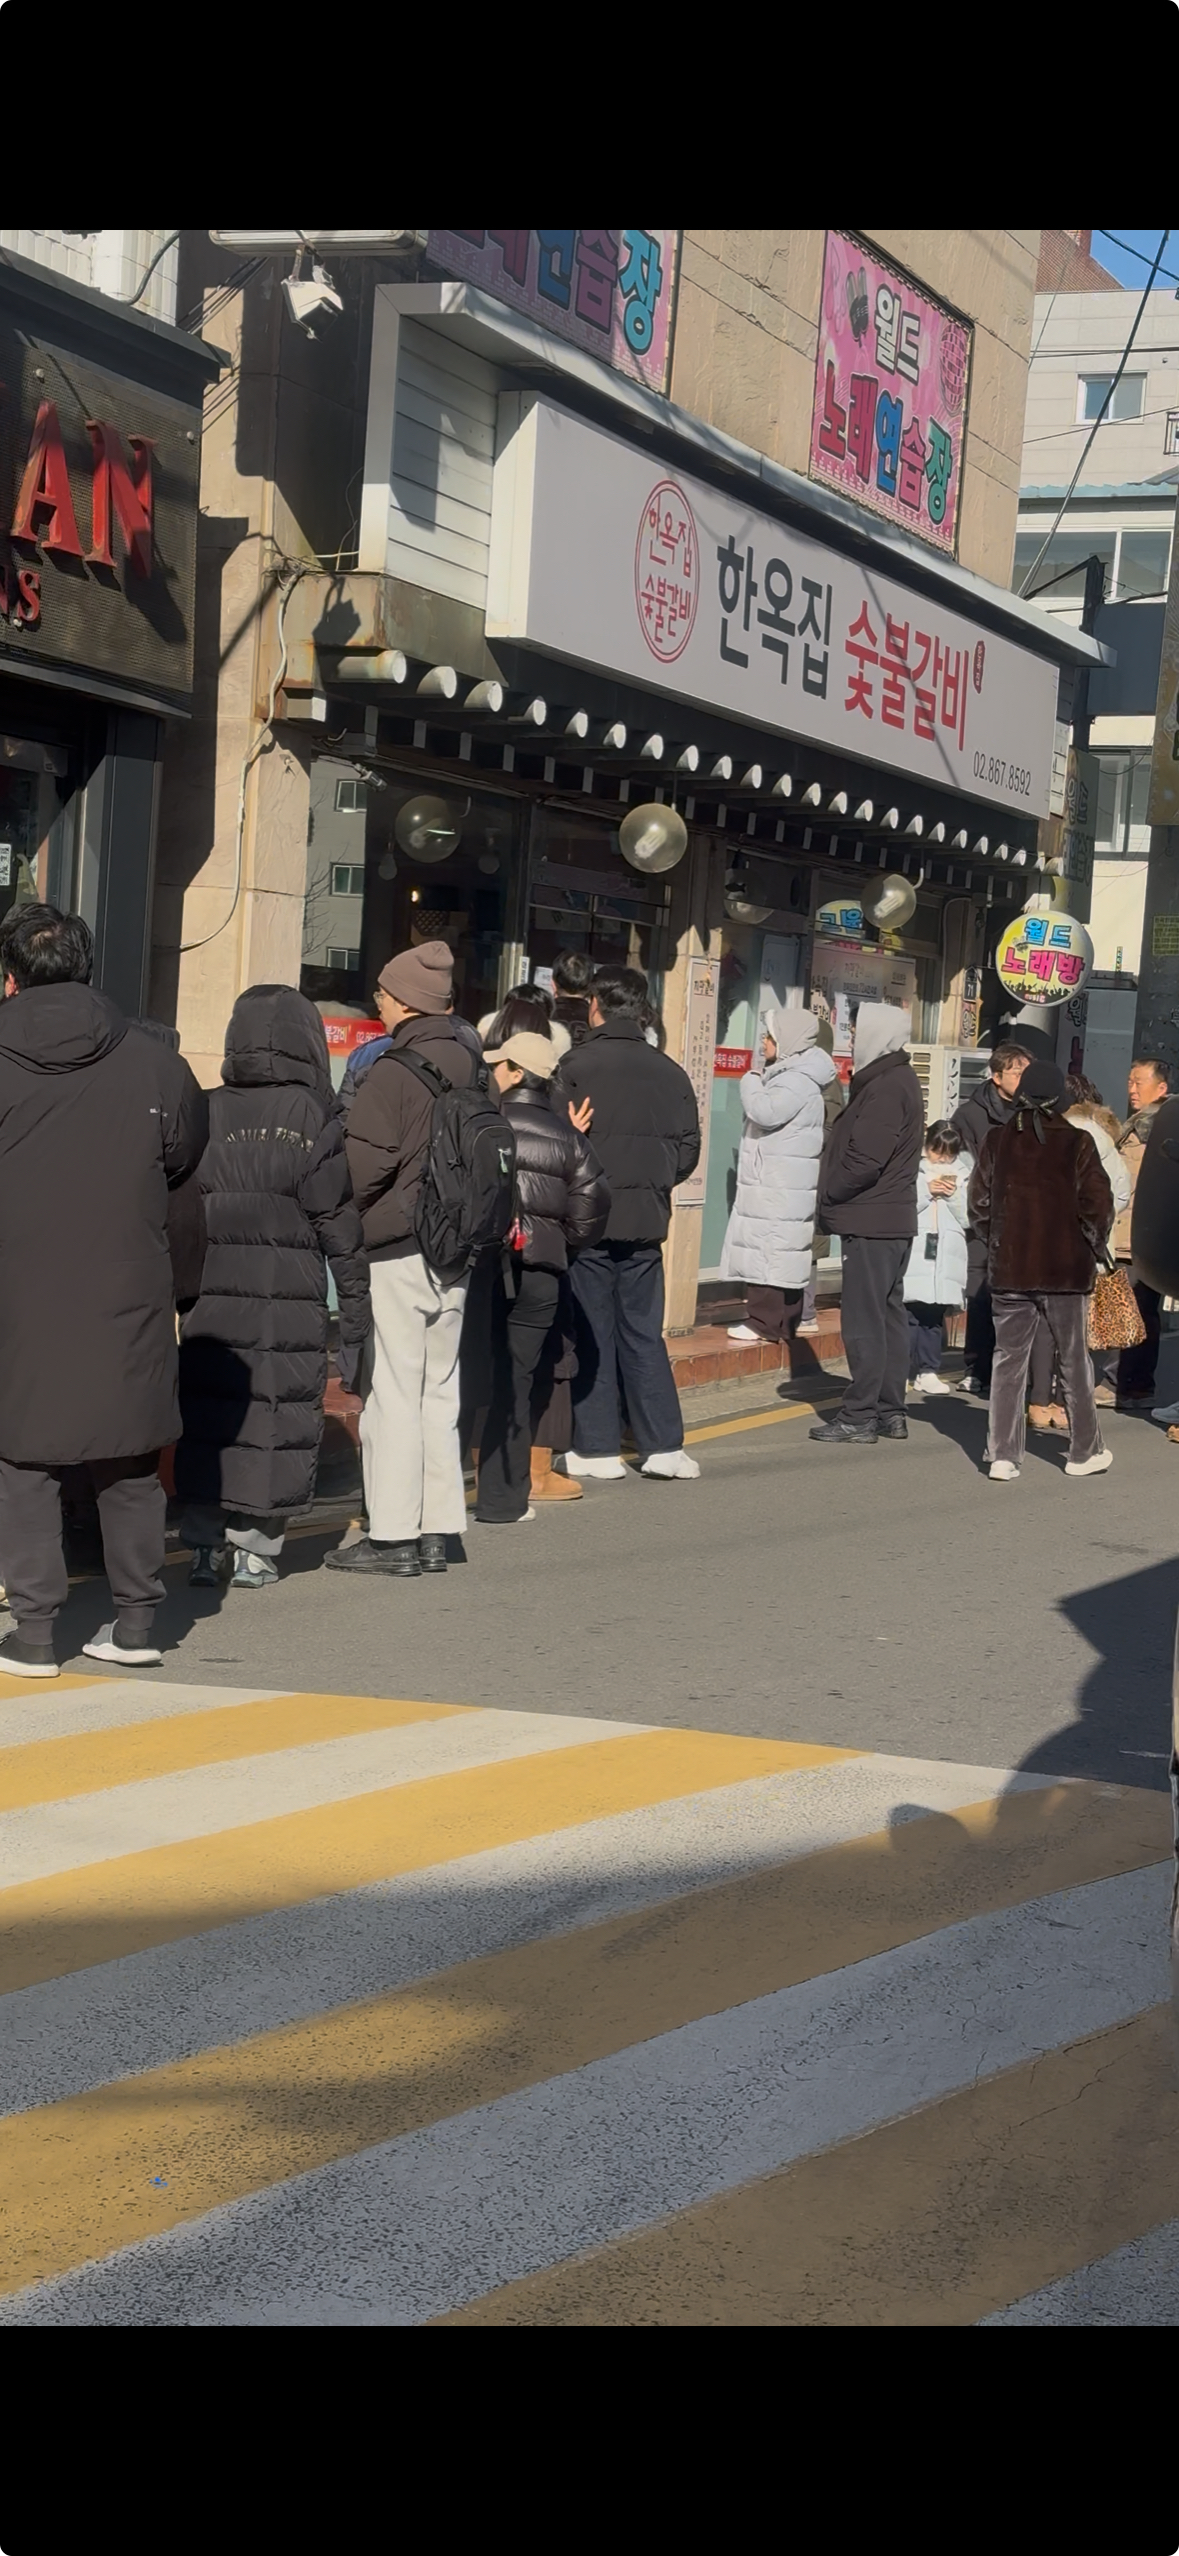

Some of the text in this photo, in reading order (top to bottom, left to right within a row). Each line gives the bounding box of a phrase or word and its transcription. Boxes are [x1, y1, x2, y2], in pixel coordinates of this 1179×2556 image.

[448, 230, 662, 354] 연습장
[875, 284, 920, 386] 월드
[8, 397, 158, 579] AN
[819, 359, 952, 525] 노래연습장
[648, 493, 692, 577] 한옥집
[641, 573, 692, 644] 숯불갈비
[716, 534, 969, 751] 한옥집 숯불갈비
[973, 750, 1031, 796] 02.867.8592
[1001, 947, 1085, 985] 노래방
[1025, 918, 1071, 948] 월드
